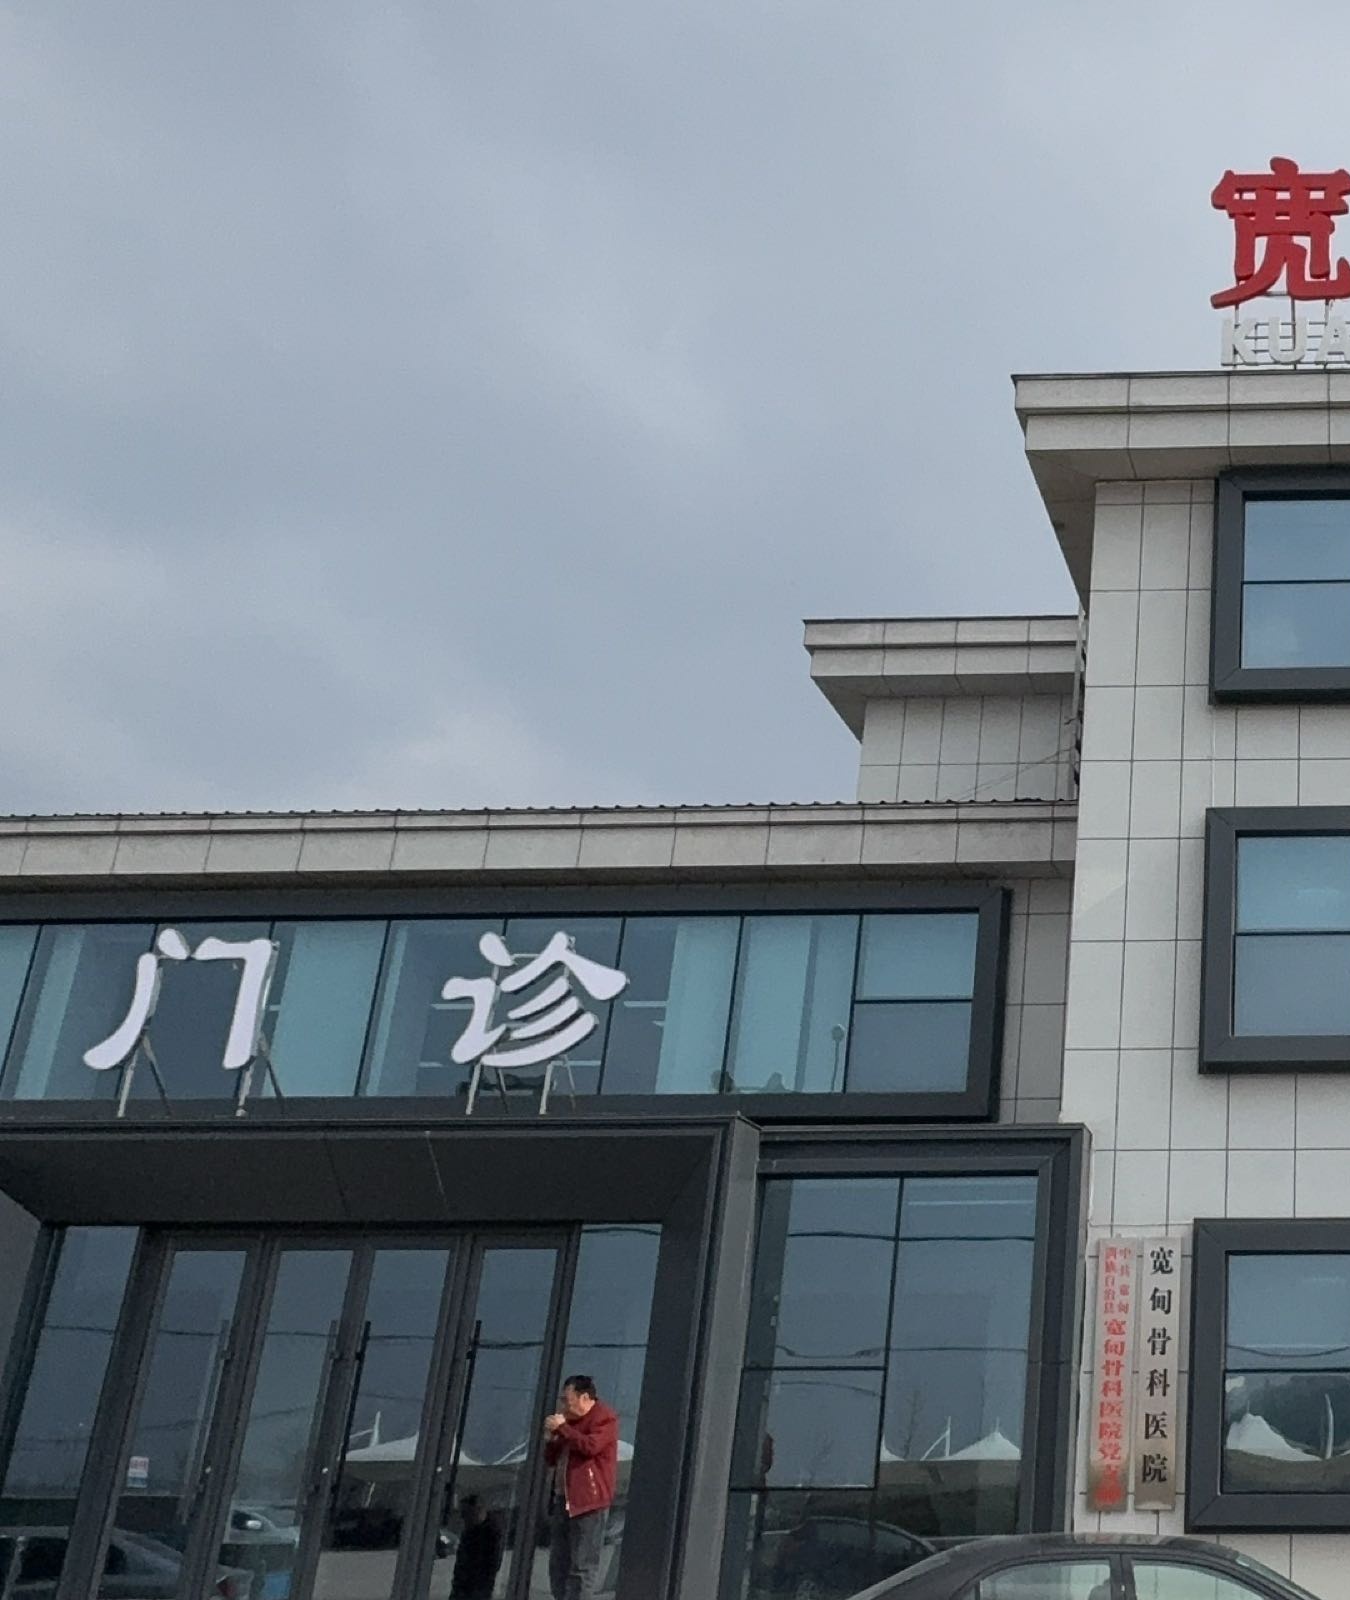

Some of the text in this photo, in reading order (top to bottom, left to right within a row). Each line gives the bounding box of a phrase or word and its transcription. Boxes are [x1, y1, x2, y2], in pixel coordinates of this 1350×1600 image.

[83, 929, 629, 1070] 门诊
[1142, 1247, 1174, 1483] 宽甸骨科医院
